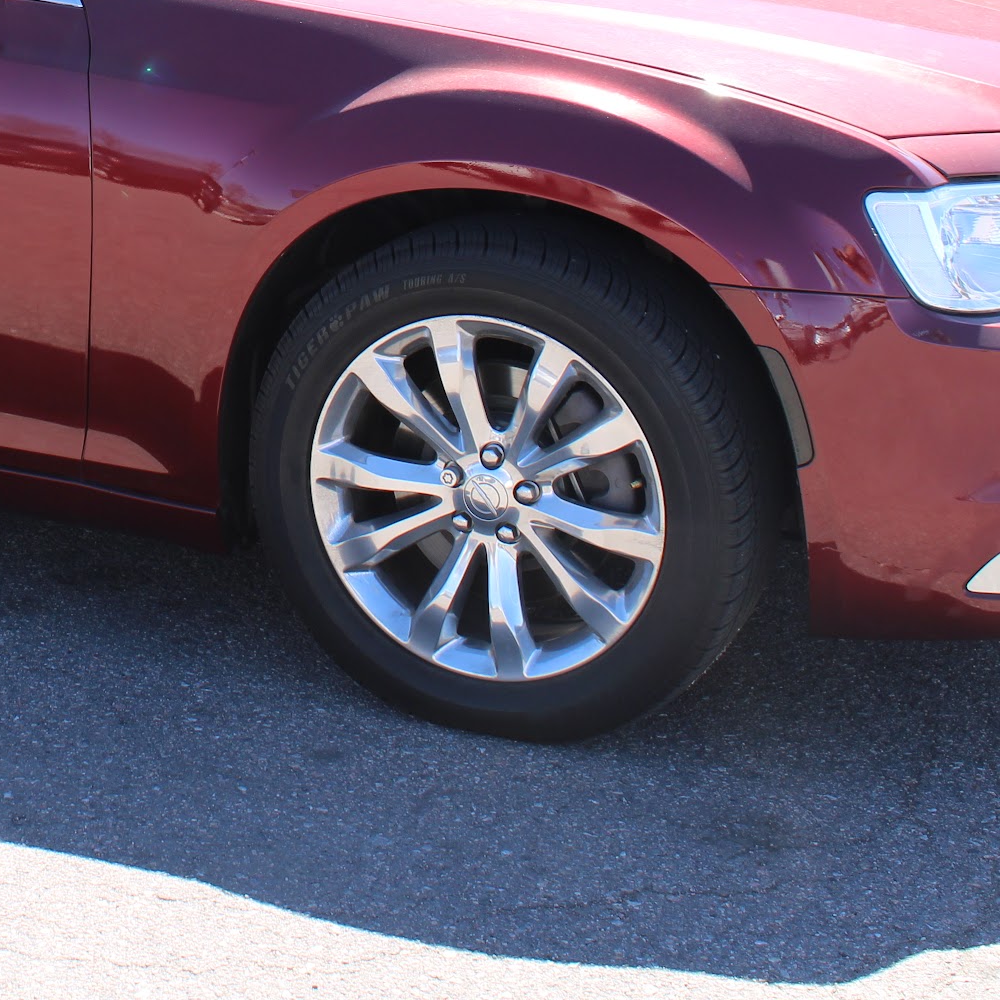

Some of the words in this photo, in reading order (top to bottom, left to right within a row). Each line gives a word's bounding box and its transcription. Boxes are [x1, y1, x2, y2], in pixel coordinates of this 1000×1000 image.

[402, 273, 443, 290] TOURING
[447, 273, 467, 284] A/S
[285, 329, 330, 390] TIGER
[345, 284, 391, 320] PAW
